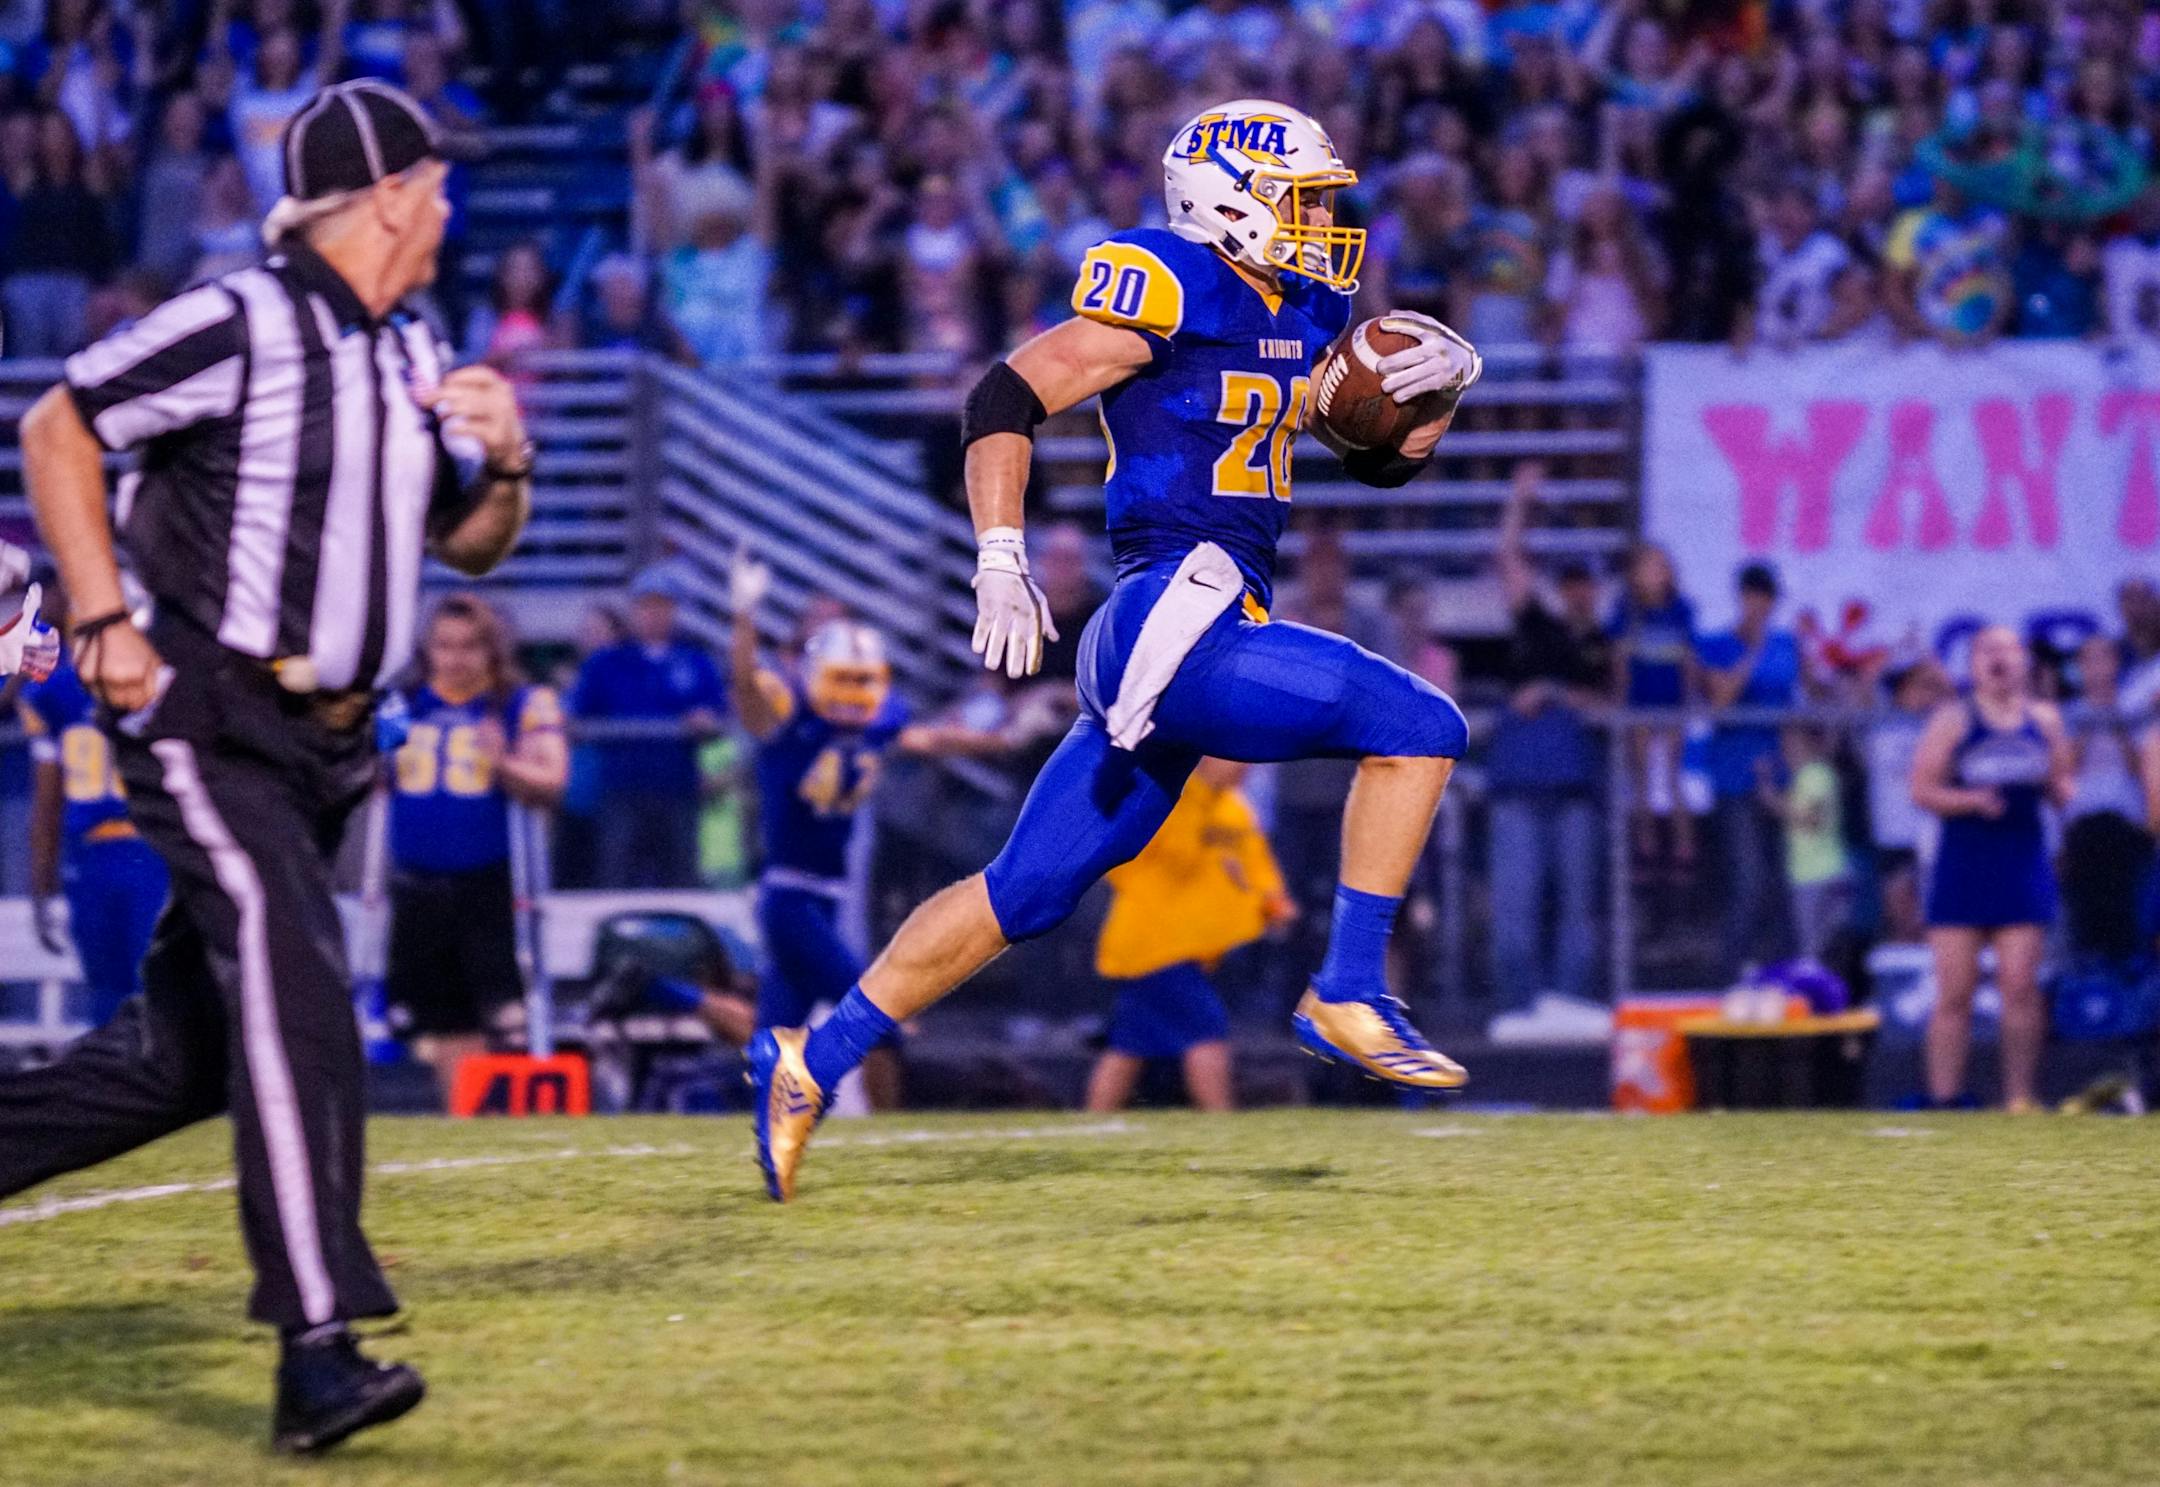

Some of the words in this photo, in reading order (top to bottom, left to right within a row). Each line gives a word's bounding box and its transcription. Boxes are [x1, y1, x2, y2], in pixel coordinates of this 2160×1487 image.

[1187, 119, 1287, 156] STMA
[1082, 259, 1148, 319] 20
[1212, 370, 1311, 502] 20
[1701, 389, 2160, 552] WANT
